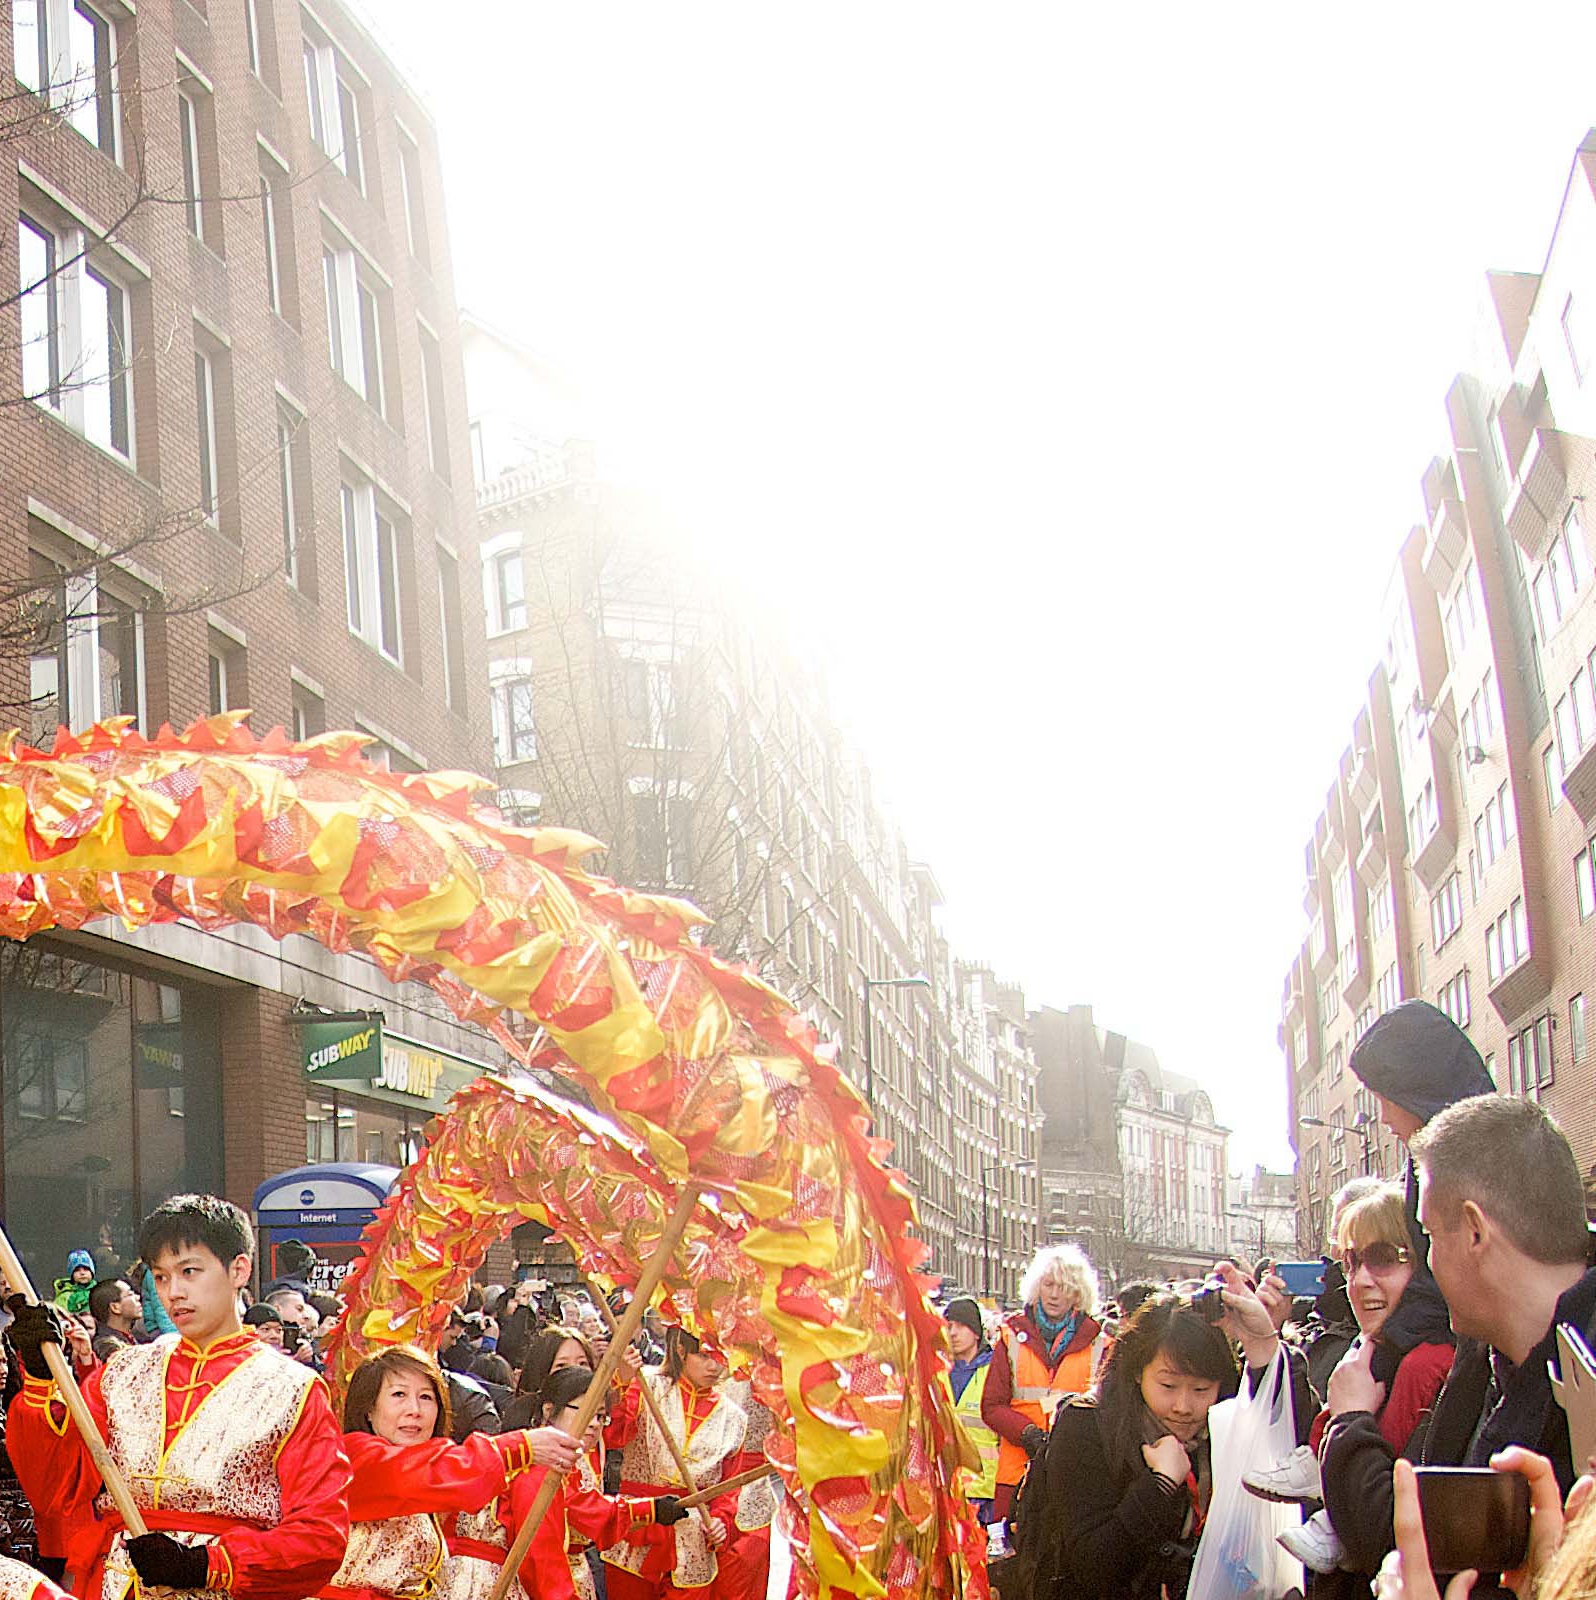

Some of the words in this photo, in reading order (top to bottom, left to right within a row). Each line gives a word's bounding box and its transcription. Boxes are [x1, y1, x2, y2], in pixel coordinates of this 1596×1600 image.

[306, 1027, 376, 1073] SUBWAY
[370, 1041, 444, 1099] SUBWAY
[300, 1212, 337, 1223] Internet
